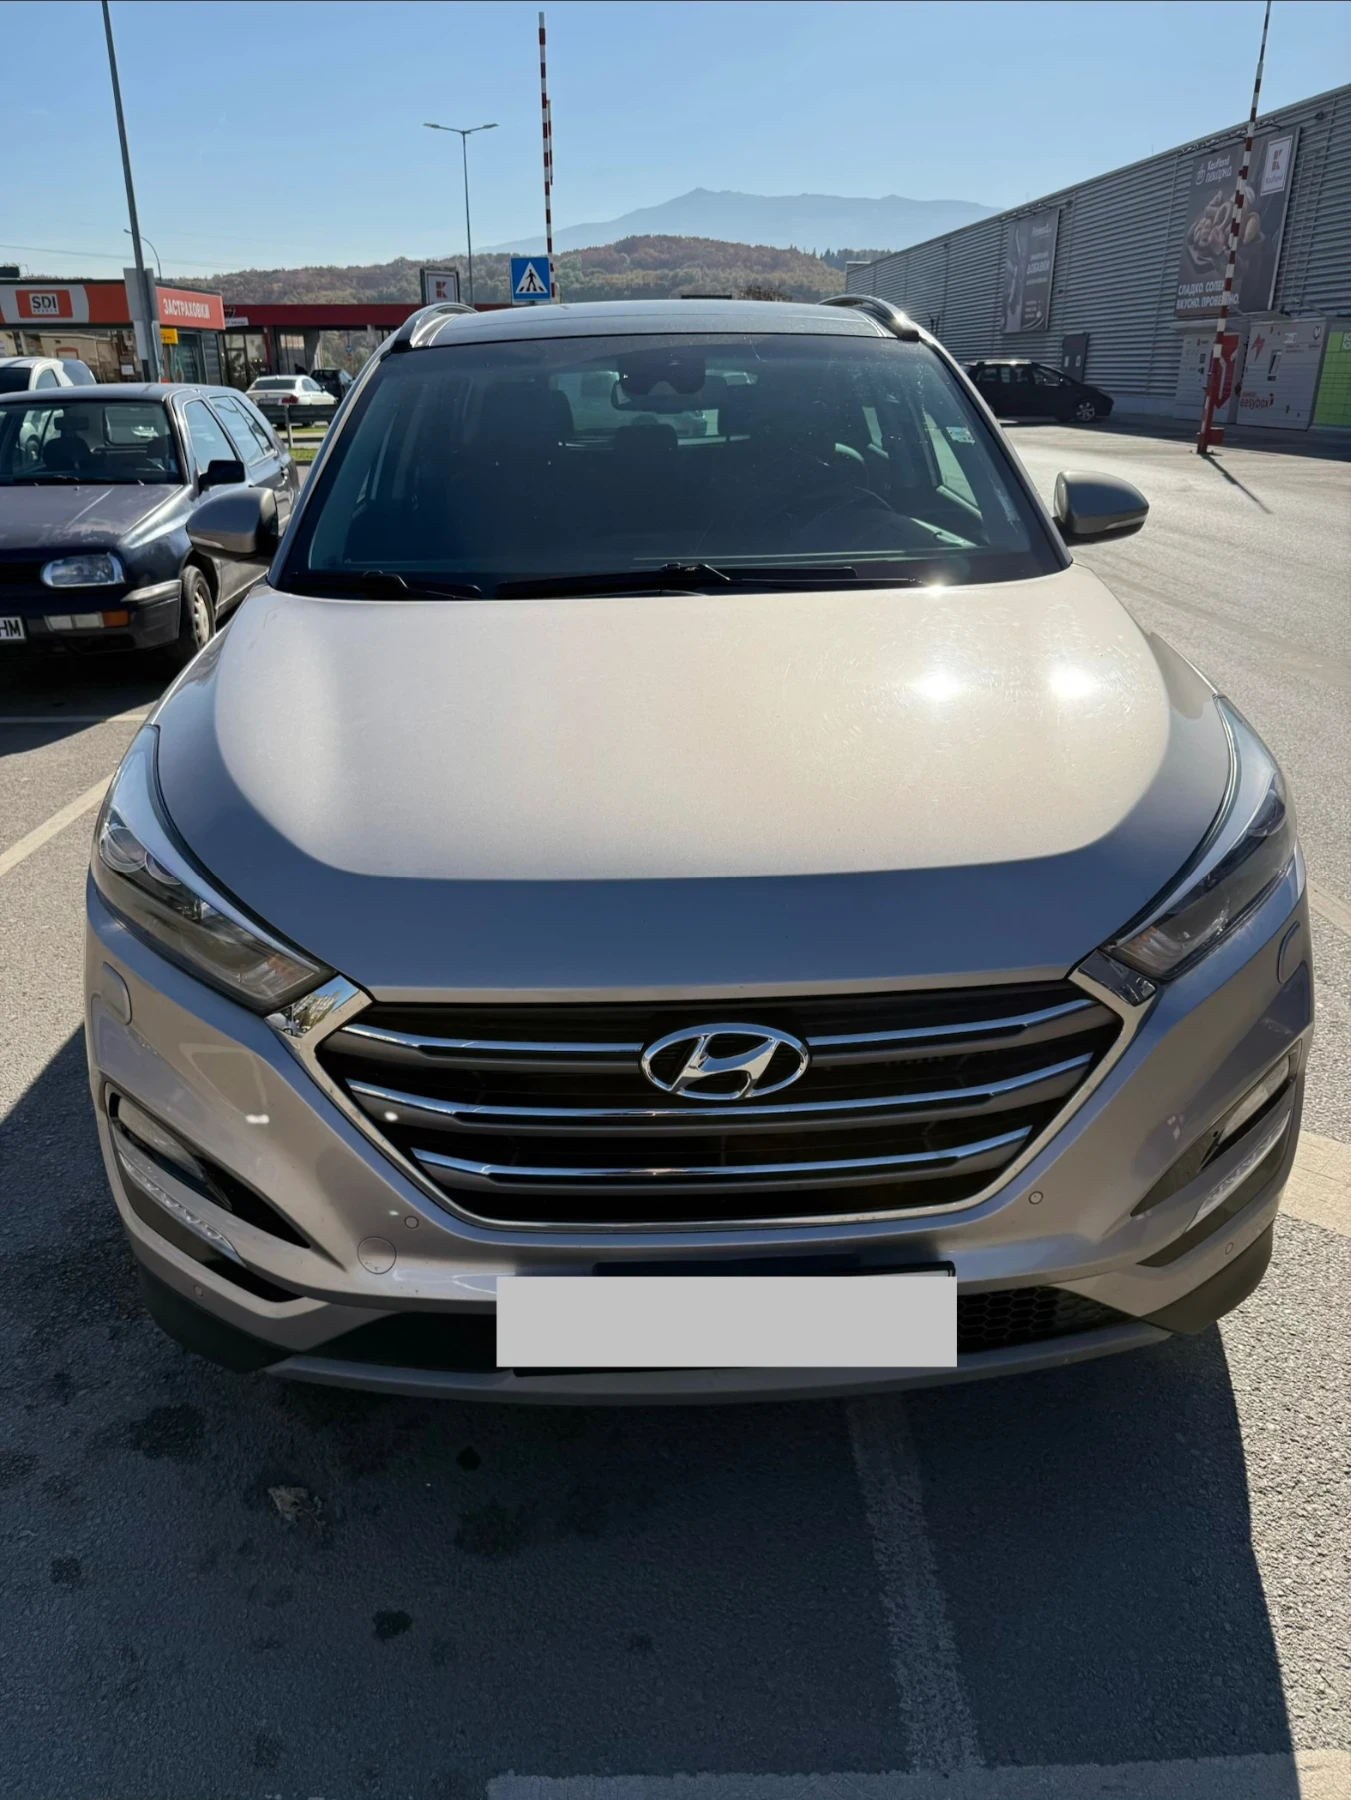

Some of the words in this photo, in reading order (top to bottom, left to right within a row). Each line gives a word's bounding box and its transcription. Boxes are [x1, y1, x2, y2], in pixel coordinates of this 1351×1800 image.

[1207, 154, 1231, 171] Kaufland
[32, 296, 57, 309] SDI
[163, 298, 210, 319] ЗАСТРАХОВКИ
